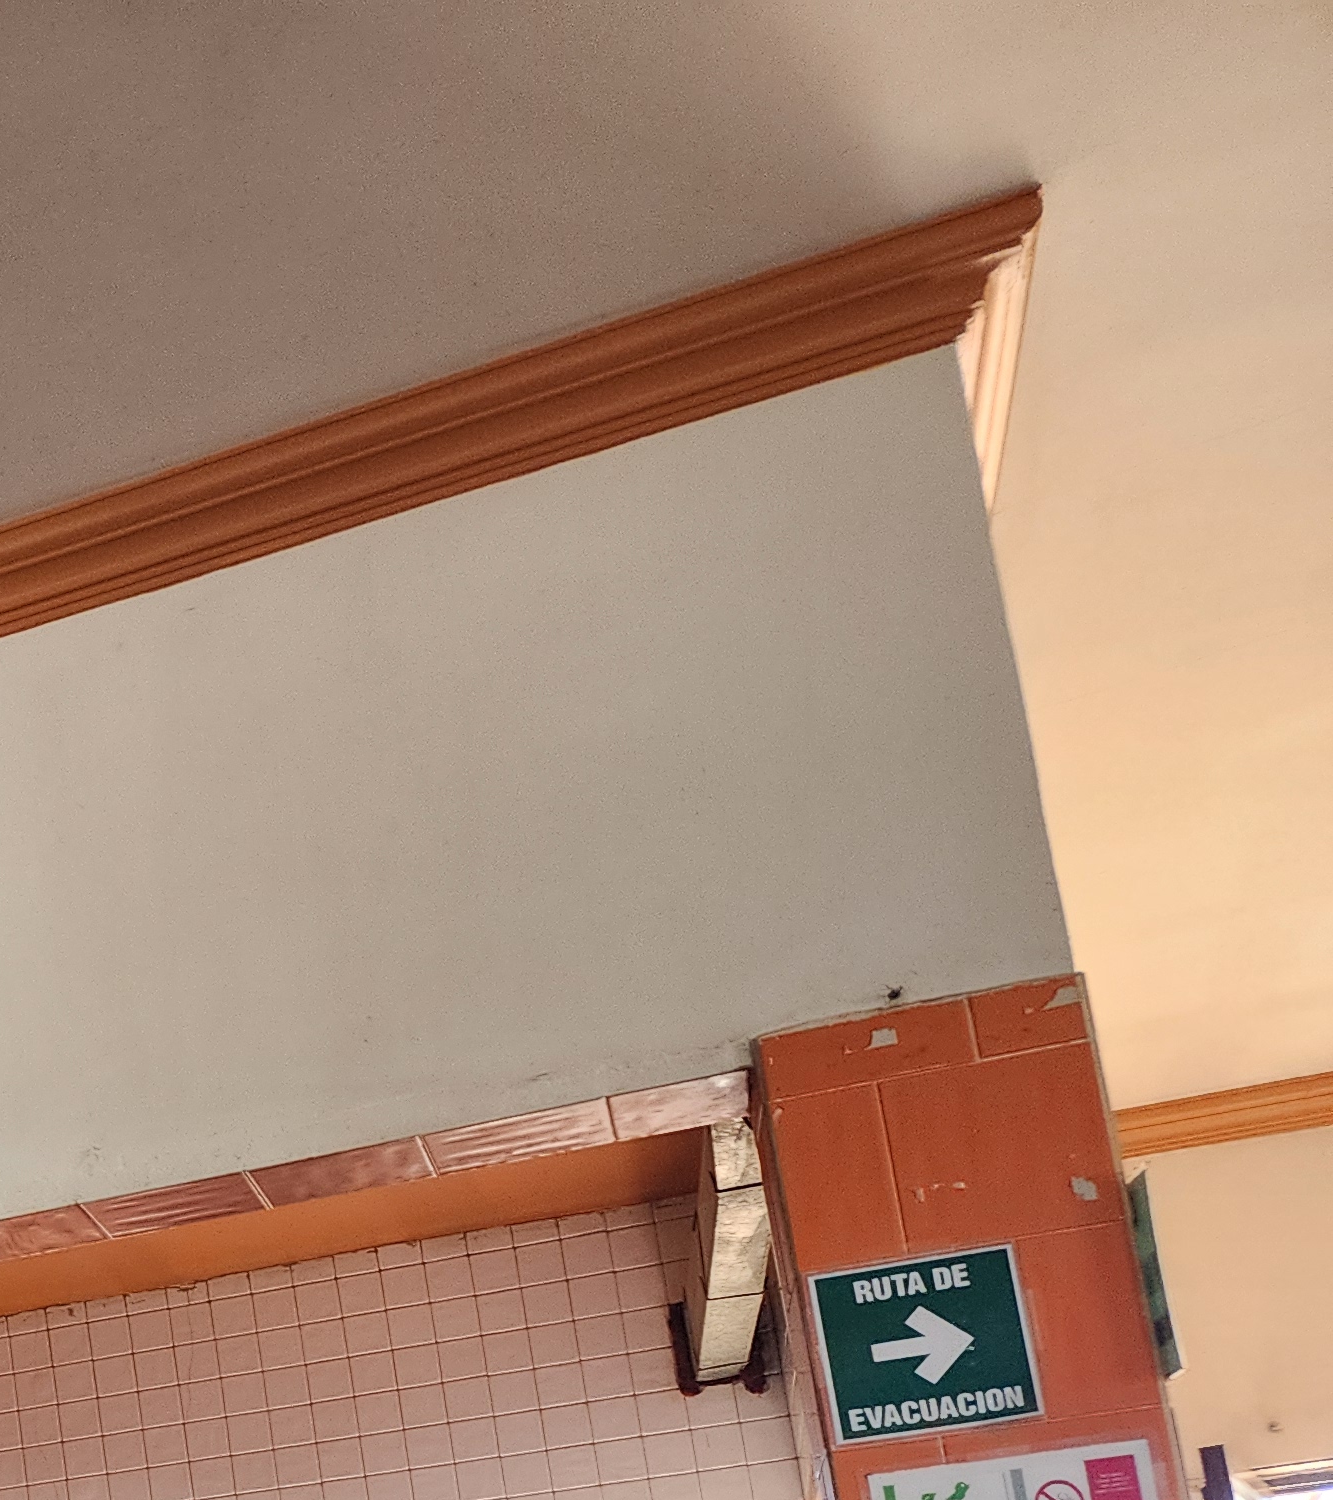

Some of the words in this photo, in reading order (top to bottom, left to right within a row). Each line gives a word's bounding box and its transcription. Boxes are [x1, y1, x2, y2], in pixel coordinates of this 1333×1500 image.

[852, 1271, 928, 1304] RUTA
[932, 1263, 971, 1291] DE
[848, 1385, 1025, 1432] EVACUACION
